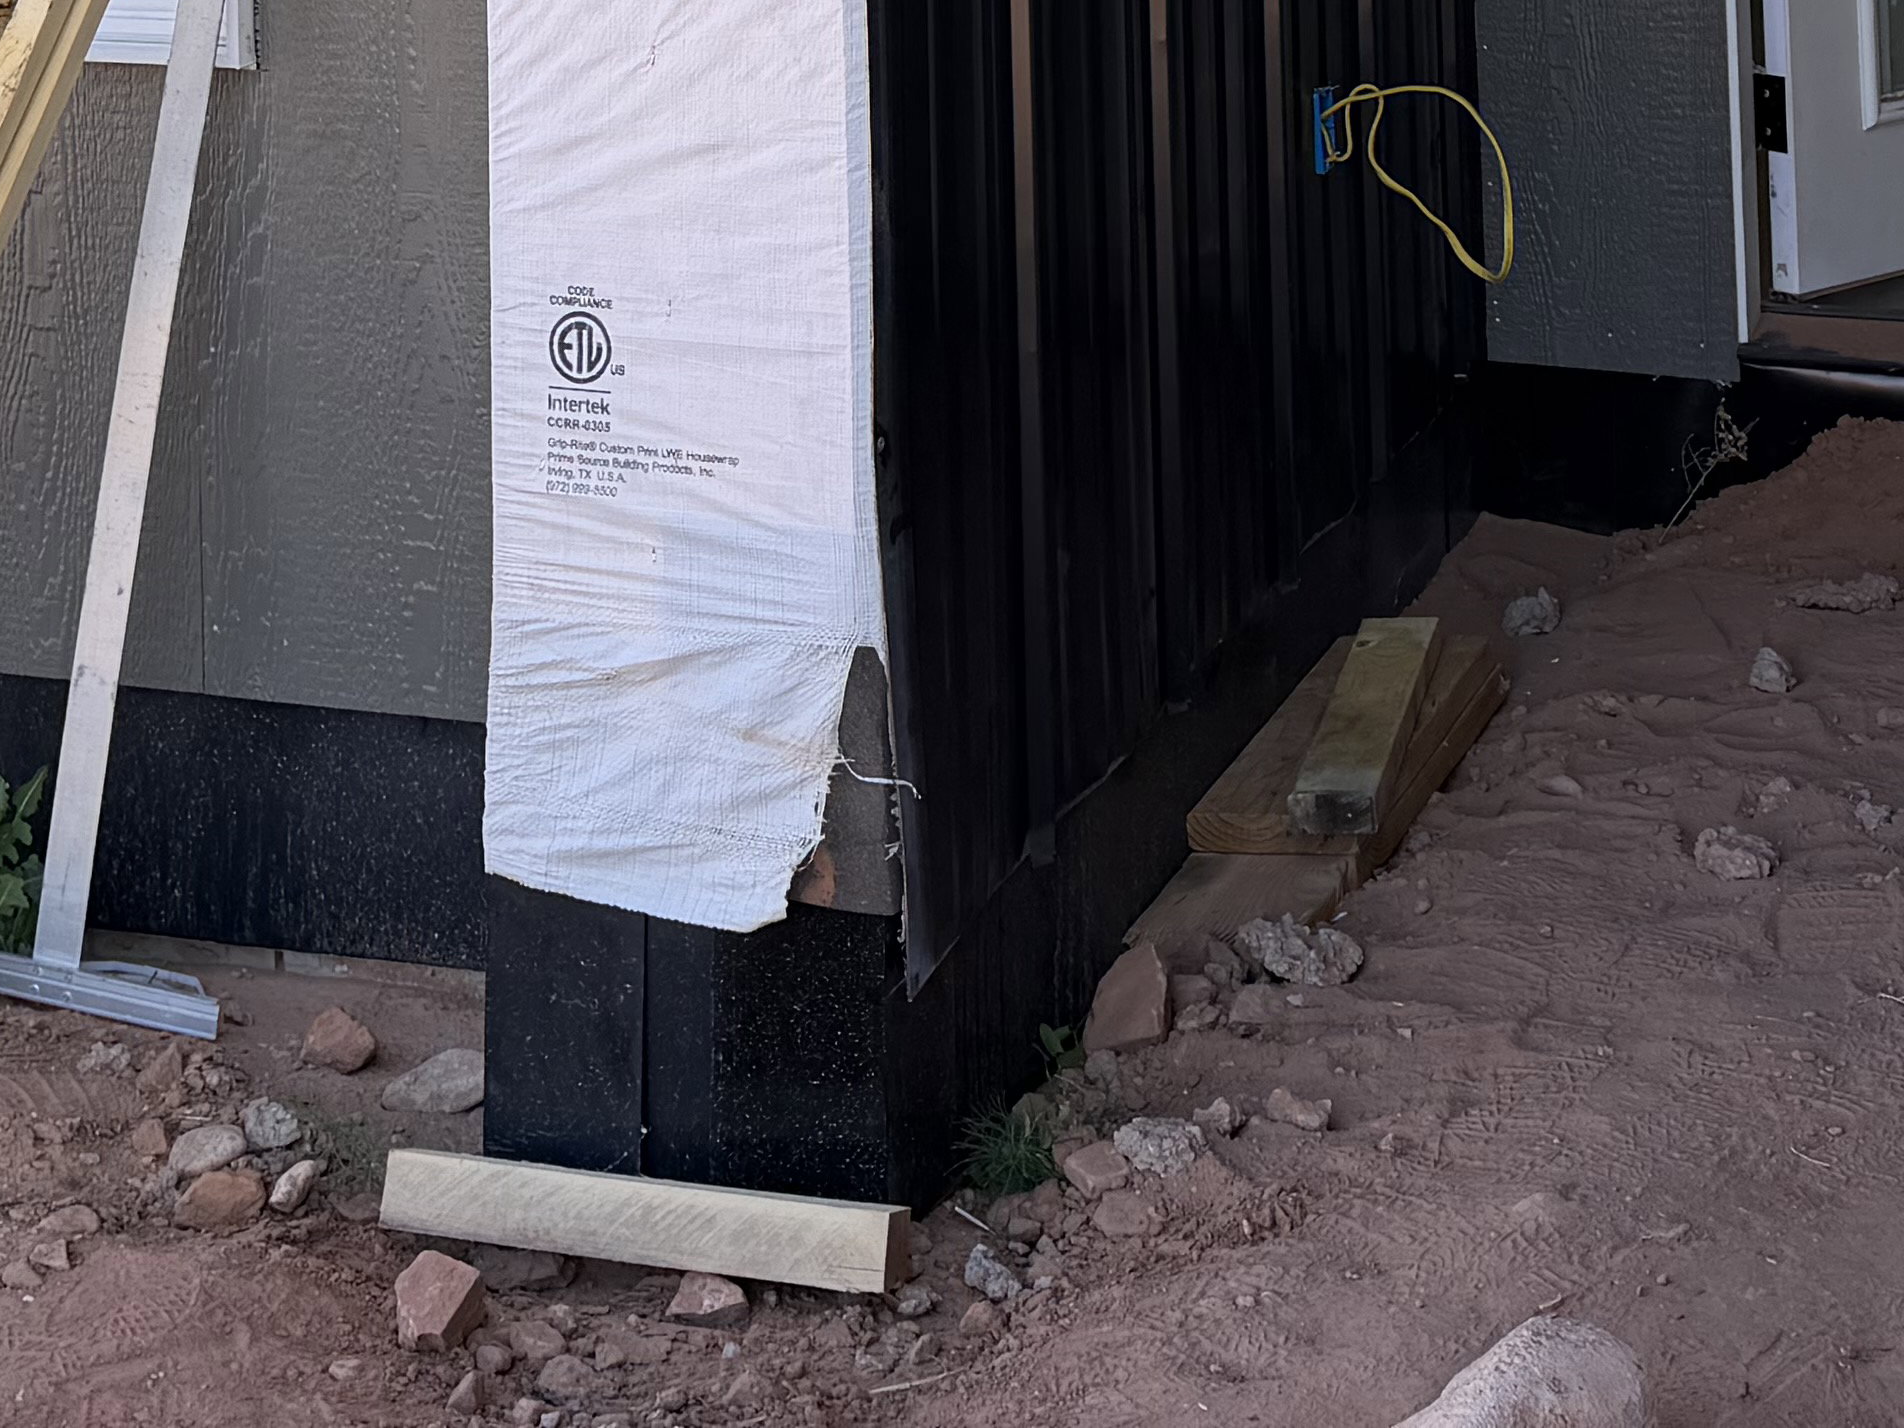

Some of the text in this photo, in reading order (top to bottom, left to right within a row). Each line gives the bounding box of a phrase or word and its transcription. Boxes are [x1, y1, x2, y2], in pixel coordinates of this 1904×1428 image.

[567, 285, 595, 297] CODE
[550, 295, 613, 310] COMPLIANCE
[548, 394, 611, 415] Intertek
[547, 417, 611, 432] CCRR-0305
[548, 452, 574, 464] Prime
[577, 455, 609, 468] Source
[612, 458, 649, 473] Building
[599, 442, 635, 456] Custom
[637, 445, 660, 457] Print
[686, 450, 740, 468] Housewrap
[578, 469, 591, 480] TX
[546, 480, 570, 494] (972)
